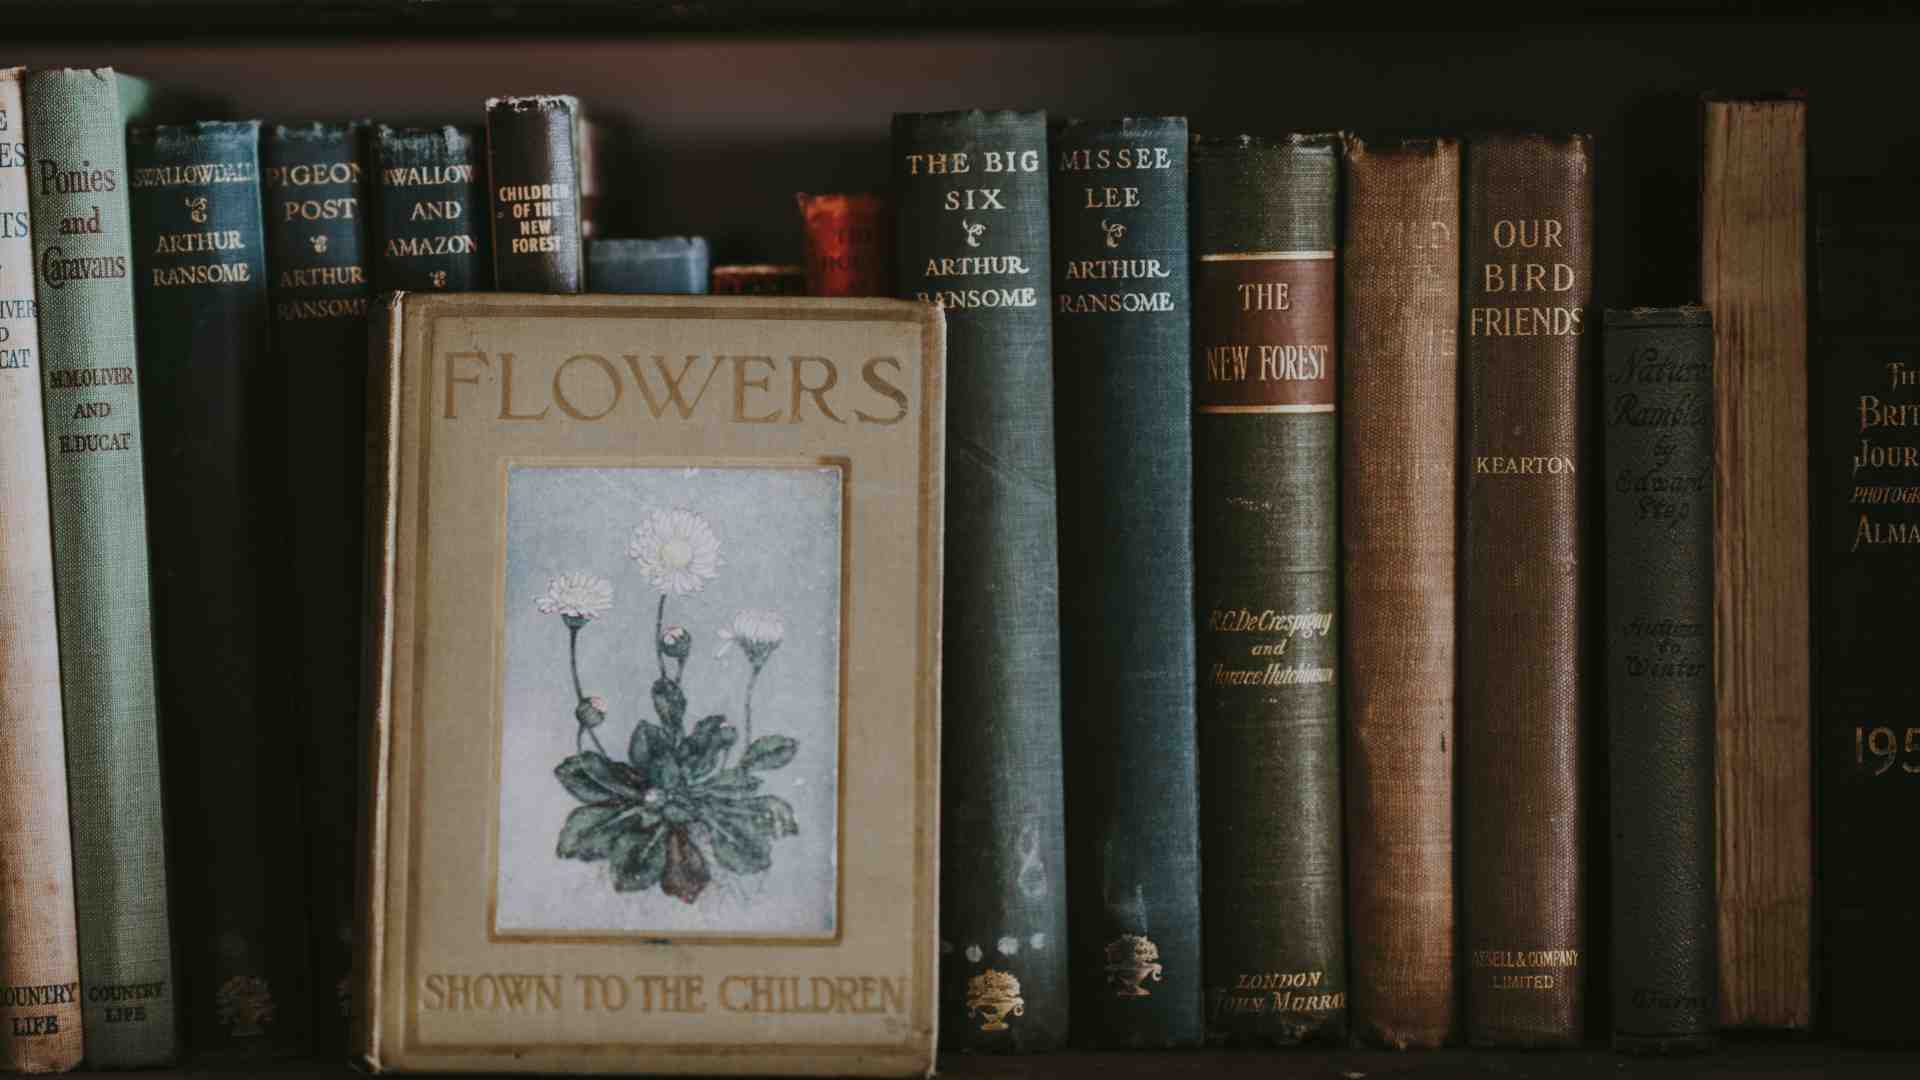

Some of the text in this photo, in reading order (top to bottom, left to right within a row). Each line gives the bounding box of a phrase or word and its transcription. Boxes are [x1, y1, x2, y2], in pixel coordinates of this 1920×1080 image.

[906, 149, 1040, 176] THE BIG
[1060, 147, 1172, 172] MISSEE
[38, 159, 116, 196] Ponies
[499, 184, 570, 202] CHILDREN
[944, 188, 1007, 211] SIX
[1084, 187, 1142, 209] LEE
[284, 198, 358, 222] POST
[409, 201, 463, 221] AND
[512, 201, 561, 218] OF THE
[62, 206, 104, 236] and
[520, 219, 552, 236] NEW
[153, 230, 247, 254] ARTHUR
[511, 236, 560, 254] FOREST
[1492, 219, 1563, 250] OUR
[384, 235, 479, 257] AMAZON
[43, 246, 127, 289] Caravans
[152, 263, 251, 287] RANSOME
[280, 266, 368, 289] ARTHUR
[925, 256, 1031, 278] ARTHUR
[1067, 259, 1171, 280] ARTHUR
[1483, 263, 1577, 292] BIRD
[915, 287, 1038, 311] RANSOME
[1061, 292, 1175, 314] RANSOME
[1237, 282, 1290, 312] THE
[1470, 306, 1585, 337] FRIENDS
[1206, 345, 1250, 382] NEW
[1258, 343, 1329, 382] FOREST
[441, 350, 910, 425] FLOWERS
[73, 402, 112, 419] AND
[1475, 456, 1576, 476] KEARTON
[1250, 638, 1288, 656] and
[1515, 951, 1527, 968] &
[1527, 949, 1579, 968] COMPANY
[1236, 970, 1323, 989] LONDON
[1488, 974, 1555, 991] LIMITED
[89, 981, 165, 1002] COUNTRY
[422, 973, 906, 1015] SHOWN TO THE CHILDREN
[11, 1014, 59, 1036] LIFE
[104, 1007, 147, 1023] LIFE
